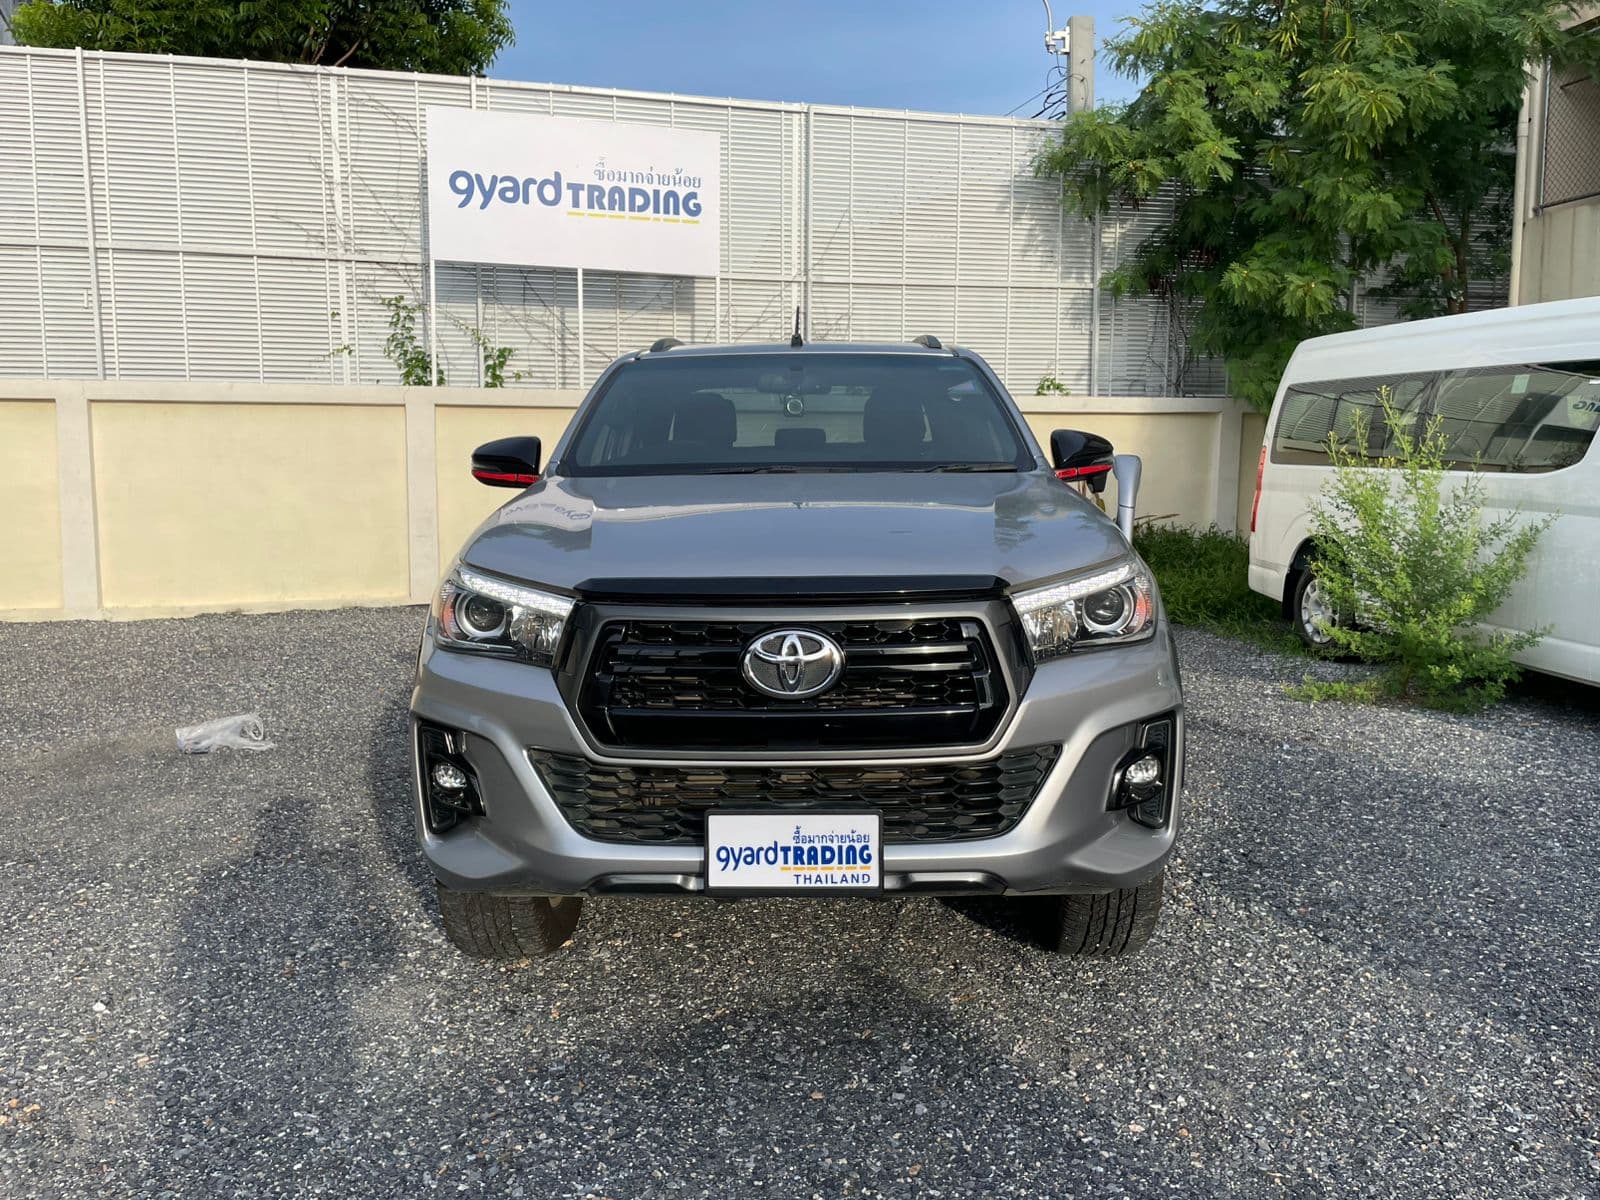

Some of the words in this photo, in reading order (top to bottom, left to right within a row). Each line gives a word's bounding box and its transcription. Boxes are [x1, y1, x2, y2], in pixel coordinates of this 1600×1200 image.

[593, 156, 702, 188] ซื้อมากจ่ายน้อย
[449, 170, 562, 210] 9yard
[566, 182, 702, 217] TRADING
[792, 825, 870, 844] ซื้อมากจ่ายน้อย
[793, 873, 871, 885] THAILAND
